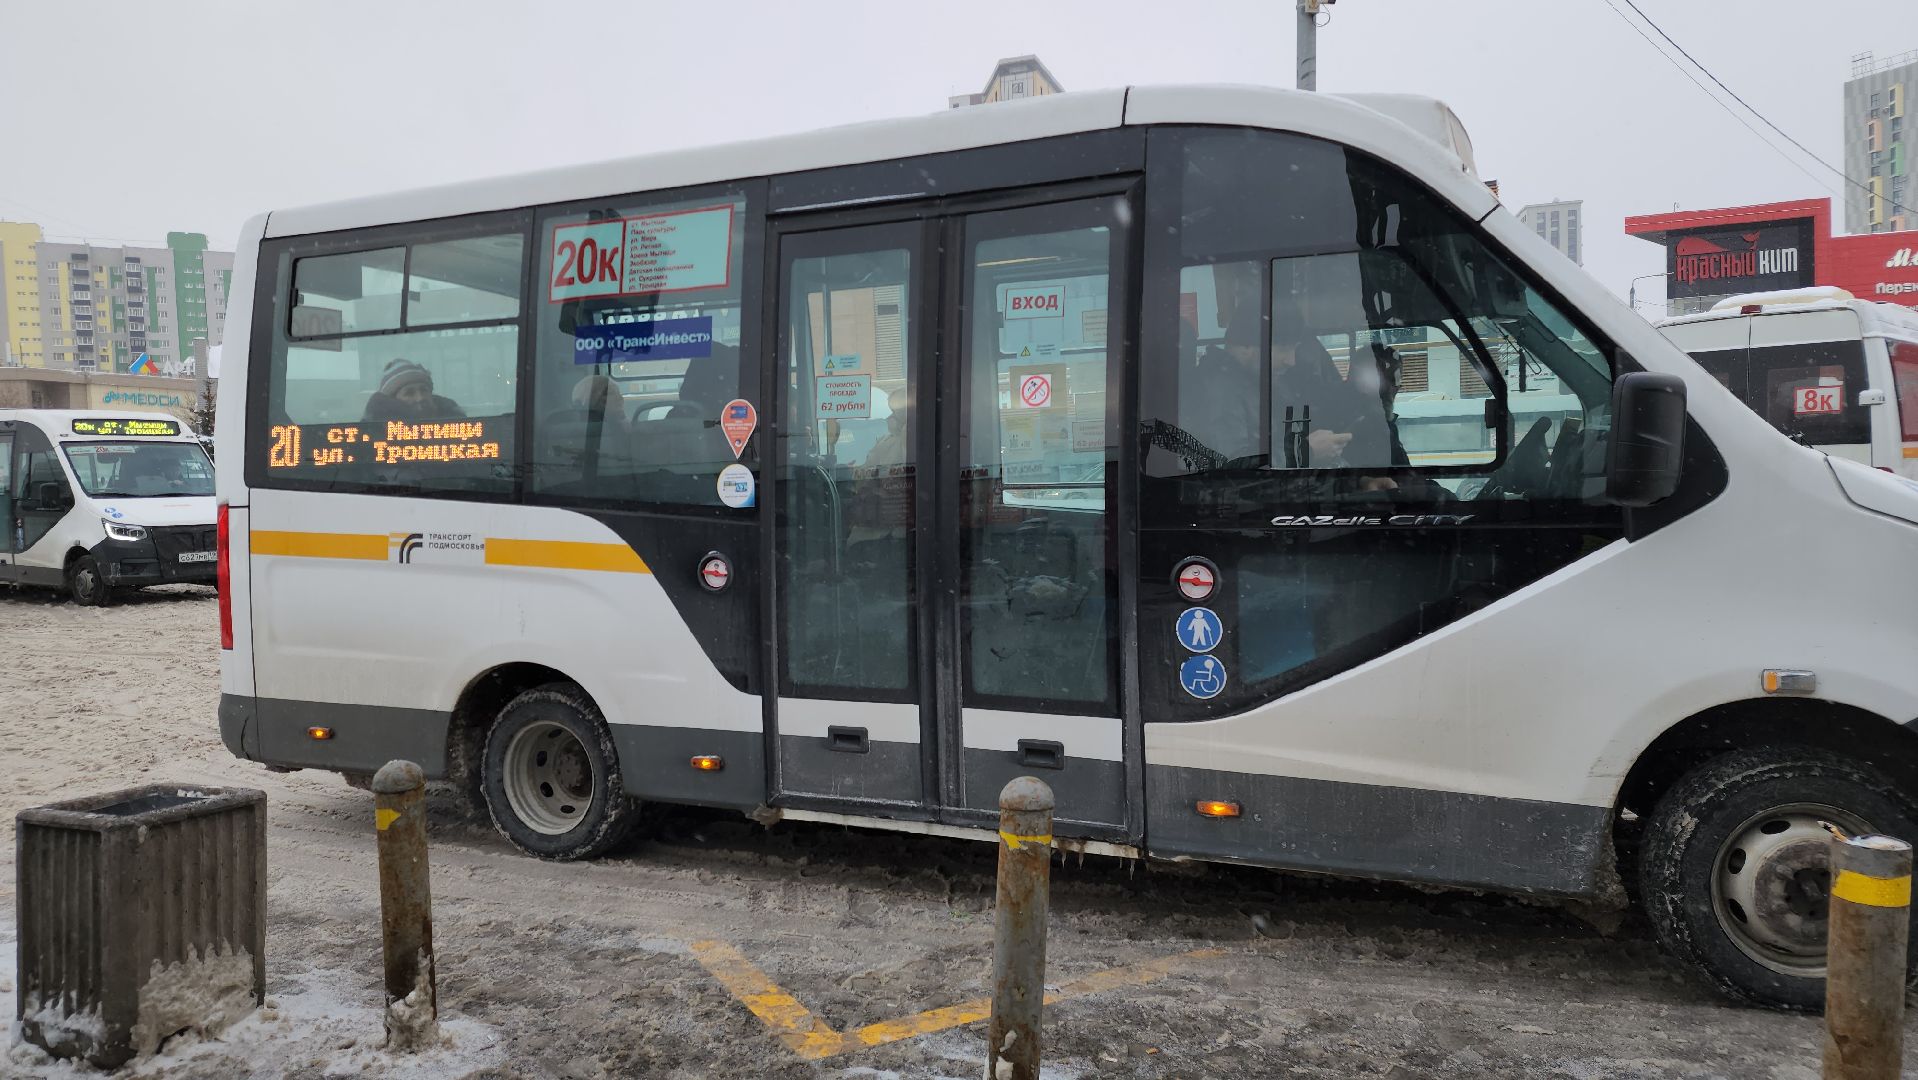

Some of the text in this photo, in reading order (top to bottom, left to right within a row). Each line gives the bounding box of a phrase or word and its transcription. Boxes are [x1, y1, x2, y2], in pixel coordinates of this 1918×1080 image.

[1012, 294, 1059, 311] ВХОД
[575, 331, 711, 351] ООО «ТрансИнвест»
[821, 401, 866, 412] 62 рубля
[270, 420, 483, 467] 20 ст. Мытищи
[313, 440, 499, 466] ул. Троицкая
[429, 533, 472, 541] ТРАНСПОРТ
[428, 542, 485, 551] ПОДМОСКОВЬЯ
